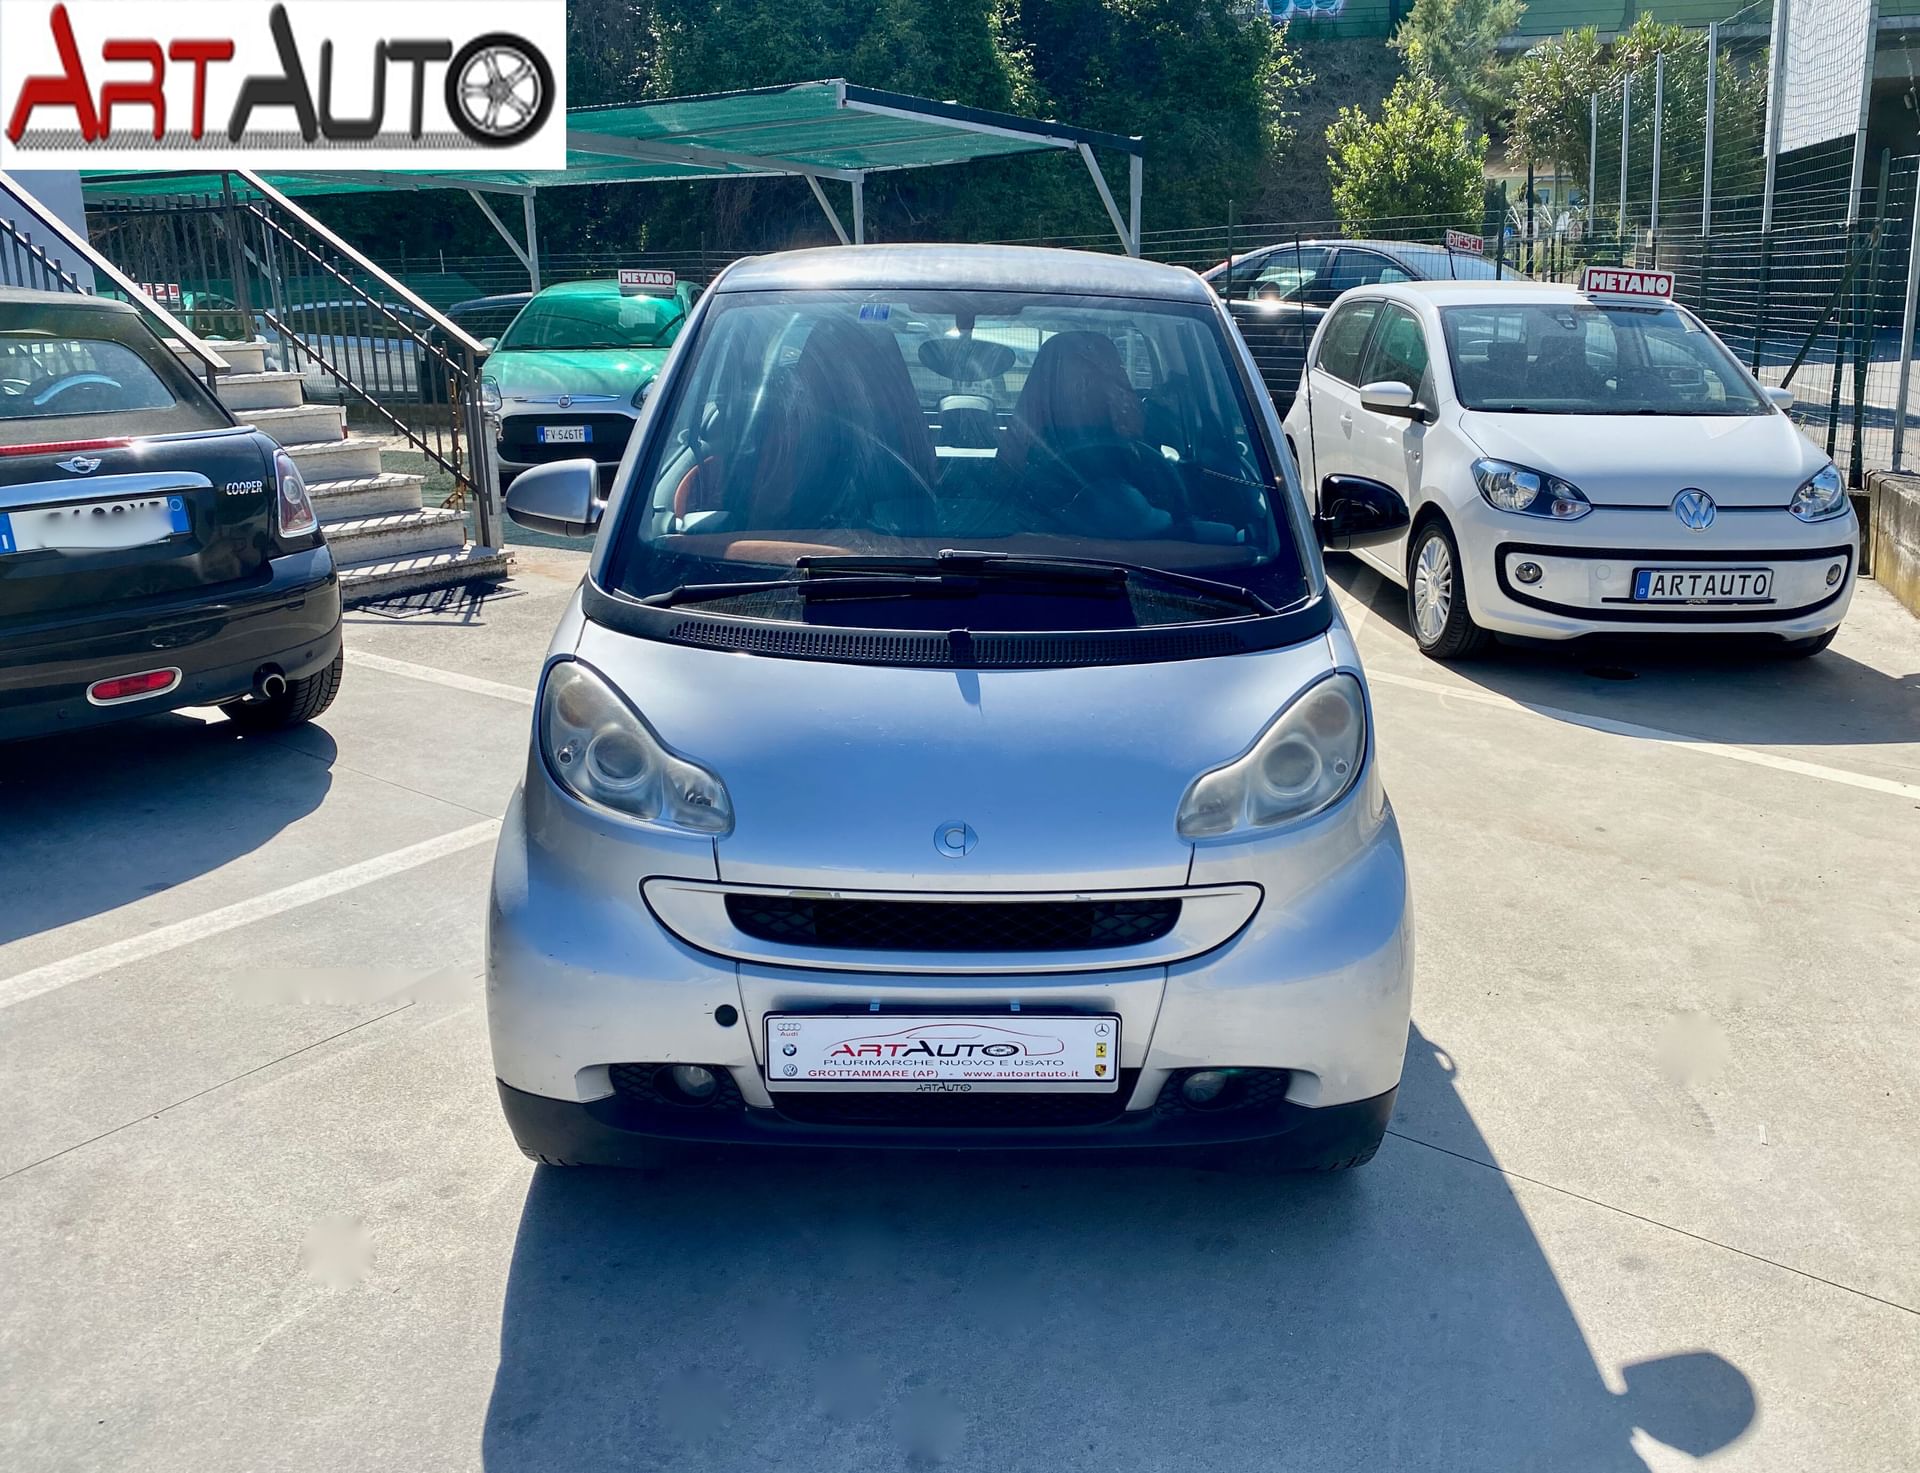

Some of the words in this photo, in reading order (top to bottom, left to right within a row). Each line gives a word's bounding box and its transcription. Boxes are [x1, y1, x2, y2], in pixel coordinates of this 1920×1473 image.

[1449, 231, 1482, 252] DIESEL
[621, 271, 672, 285] METANO
[1589, 271, 1669, 295] METANO
[545, 429, 556, 440] FV
[226, 480, 263, 496] COOPER
[1651, 574, 1767, 597] ARTAUTO
[823, 1059, 934, 1067] PLURIMARCHE
[939, 1059, 995, 1067] NUOVO
[999, 1059, 1009, 1067] E
[1014, 1059, 1065, 1067] USATO
[808, 1069, 909, 1078] GROTTAMMARE
[912, 1069, 939, 1079] (AP)
[962, 1070, 1079, 1078] www.autoartauto.it
